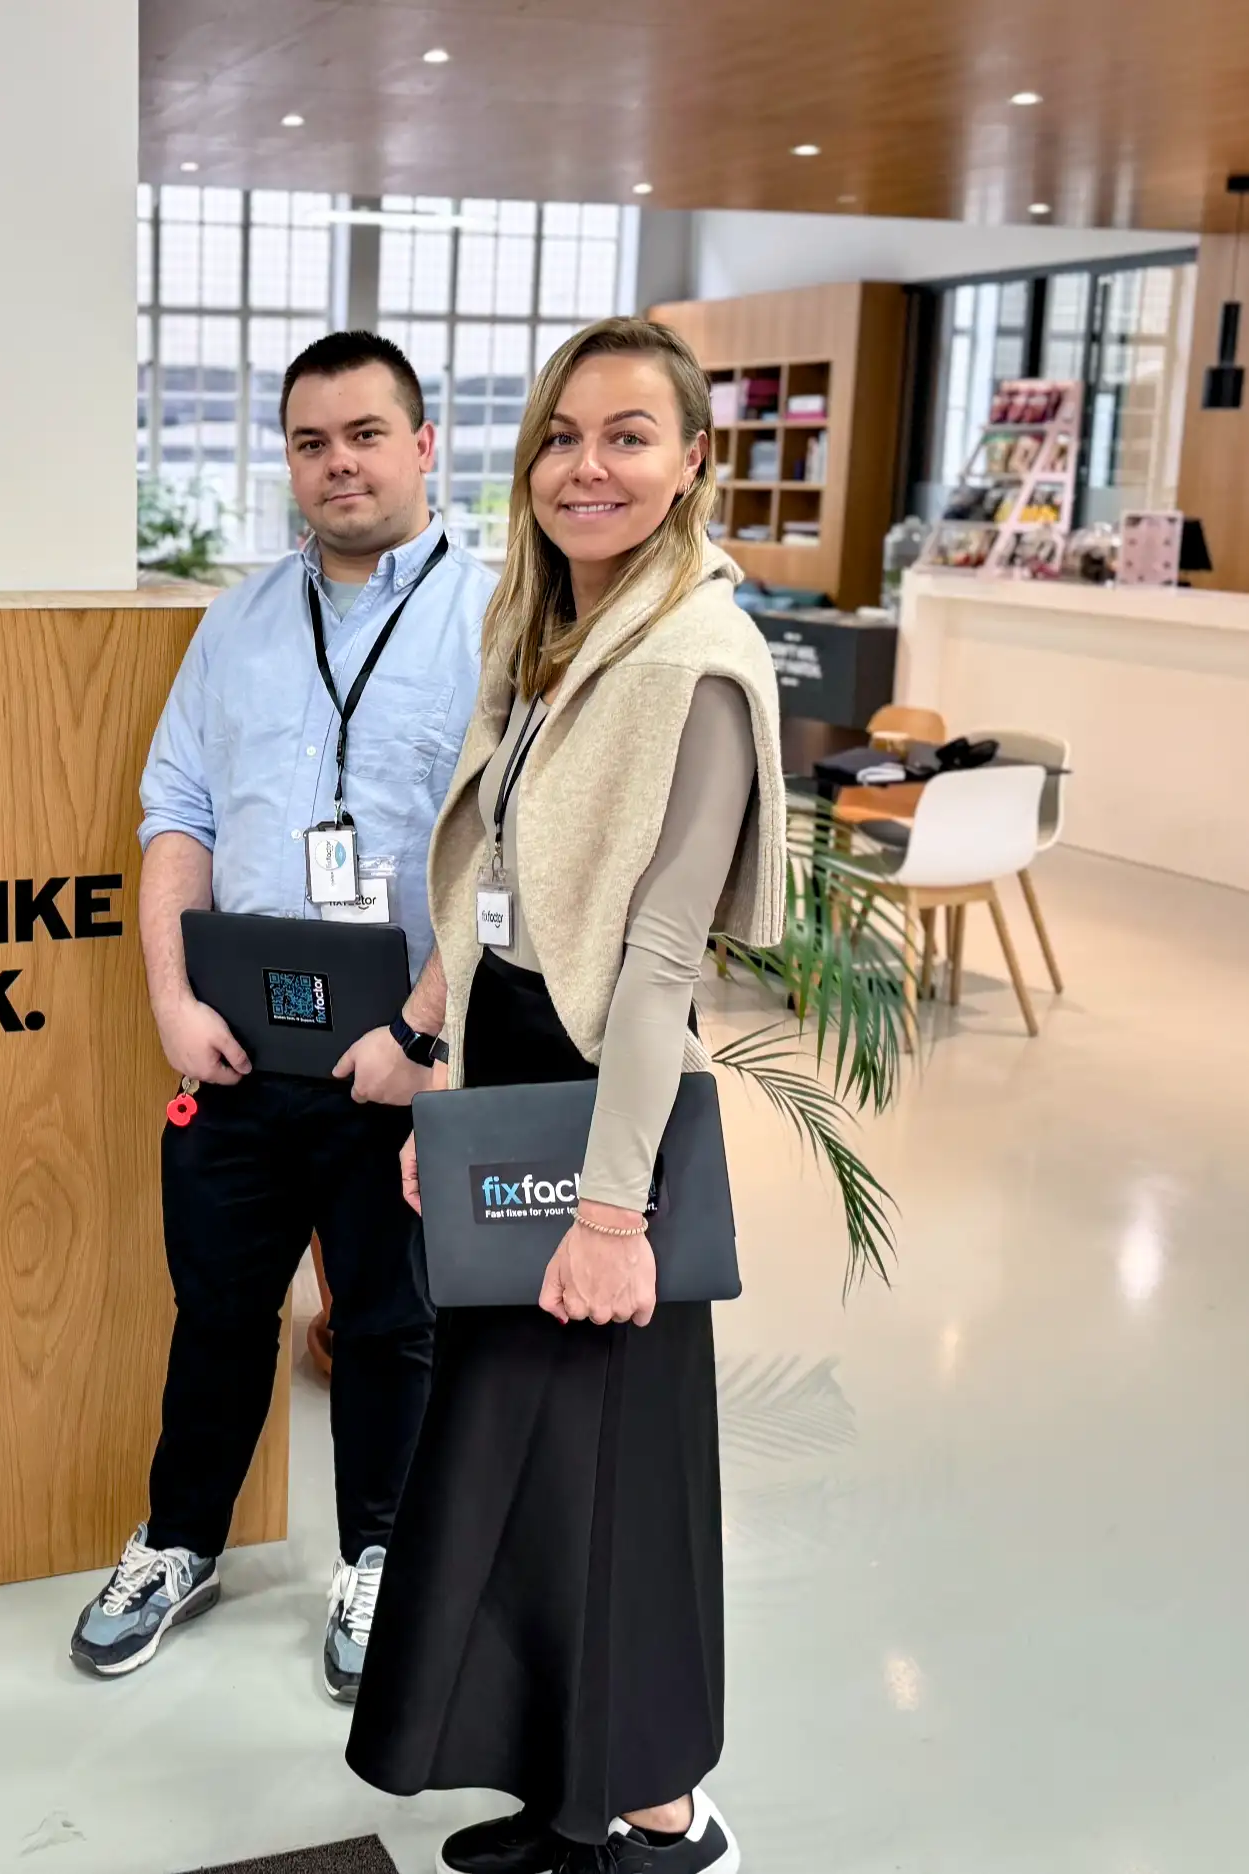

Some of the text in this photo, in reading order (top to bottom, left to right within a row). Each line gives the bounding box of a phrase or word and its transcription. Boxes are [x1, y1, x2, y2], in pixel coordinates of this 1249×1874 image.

[313, 976, 326, 1024] fixfactor
[482, 1173, 581, 1206] fixfact
[485, 1210, 505, 1219] Fast
[506, 1208, 528, 1218] fixes
[530, 1207, 542, 1216] for
[544, 1206, 565, 1216] your
